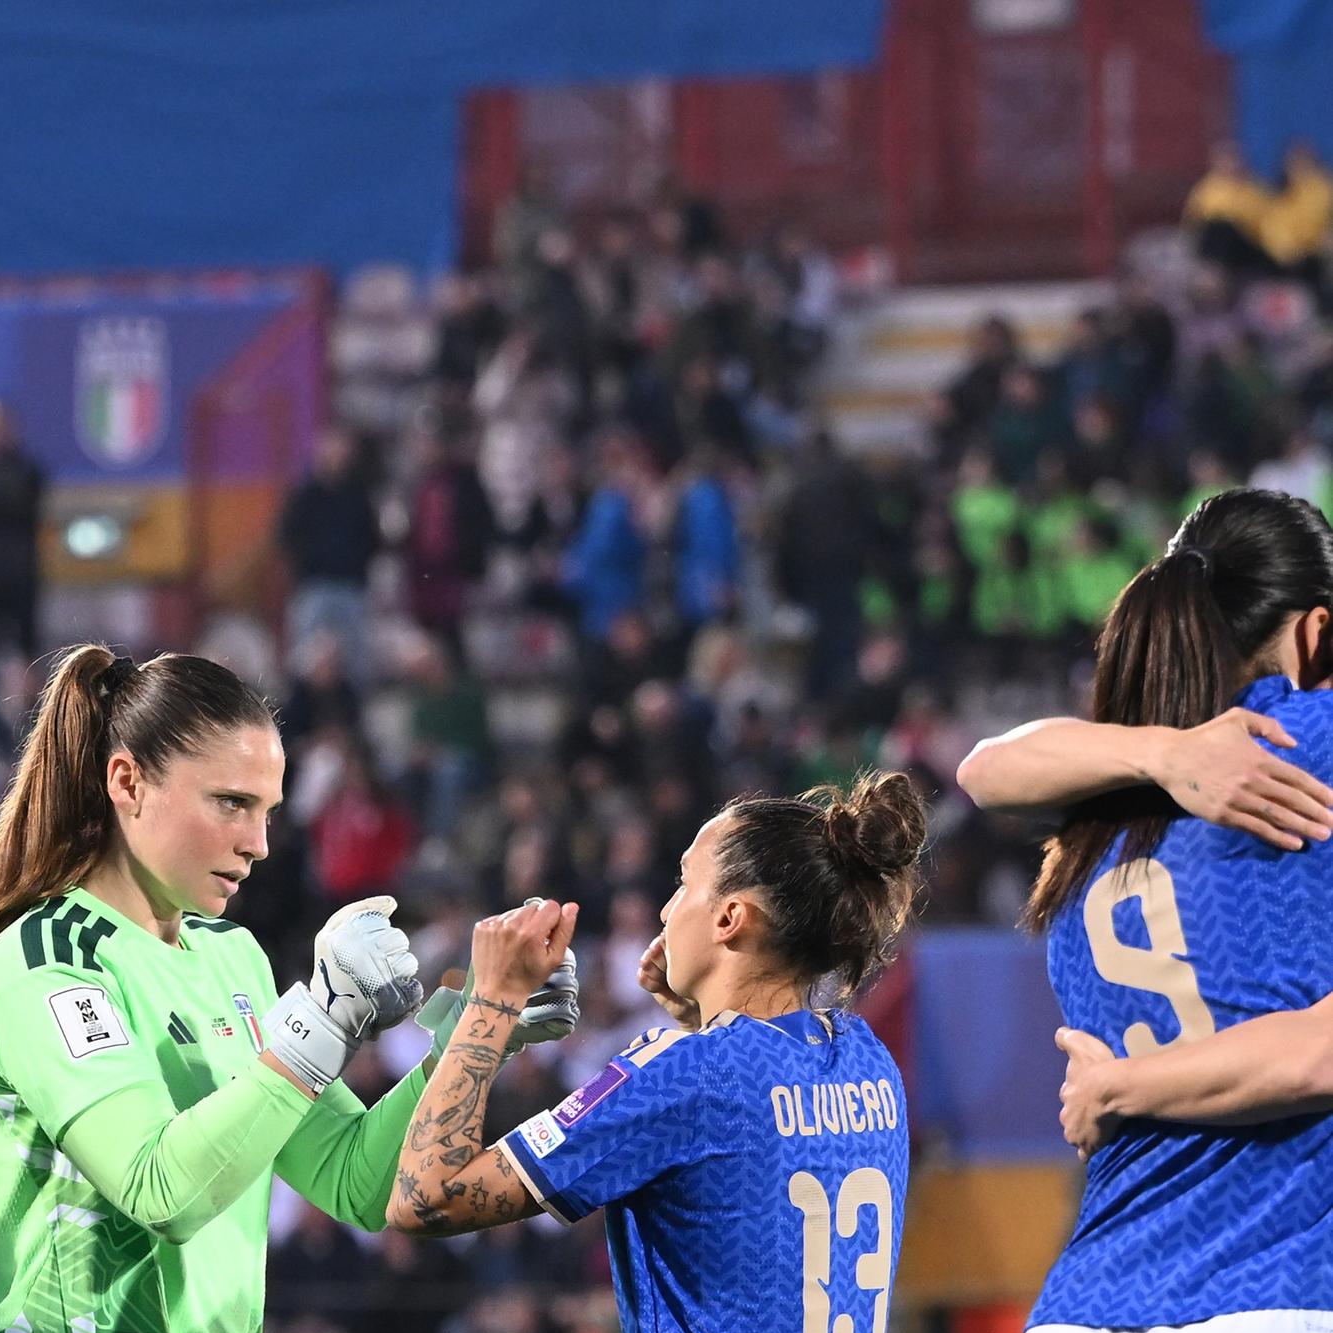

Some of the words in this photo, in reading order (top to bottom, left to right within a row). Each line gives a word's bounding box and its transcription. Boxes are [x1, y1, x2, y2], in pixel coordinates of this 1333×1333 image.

[1083, 857, 1216, 1058] 9
[284, 1013, 311, 1040] LG1
[770, 1079, 898, 1137] OLIVIERO
